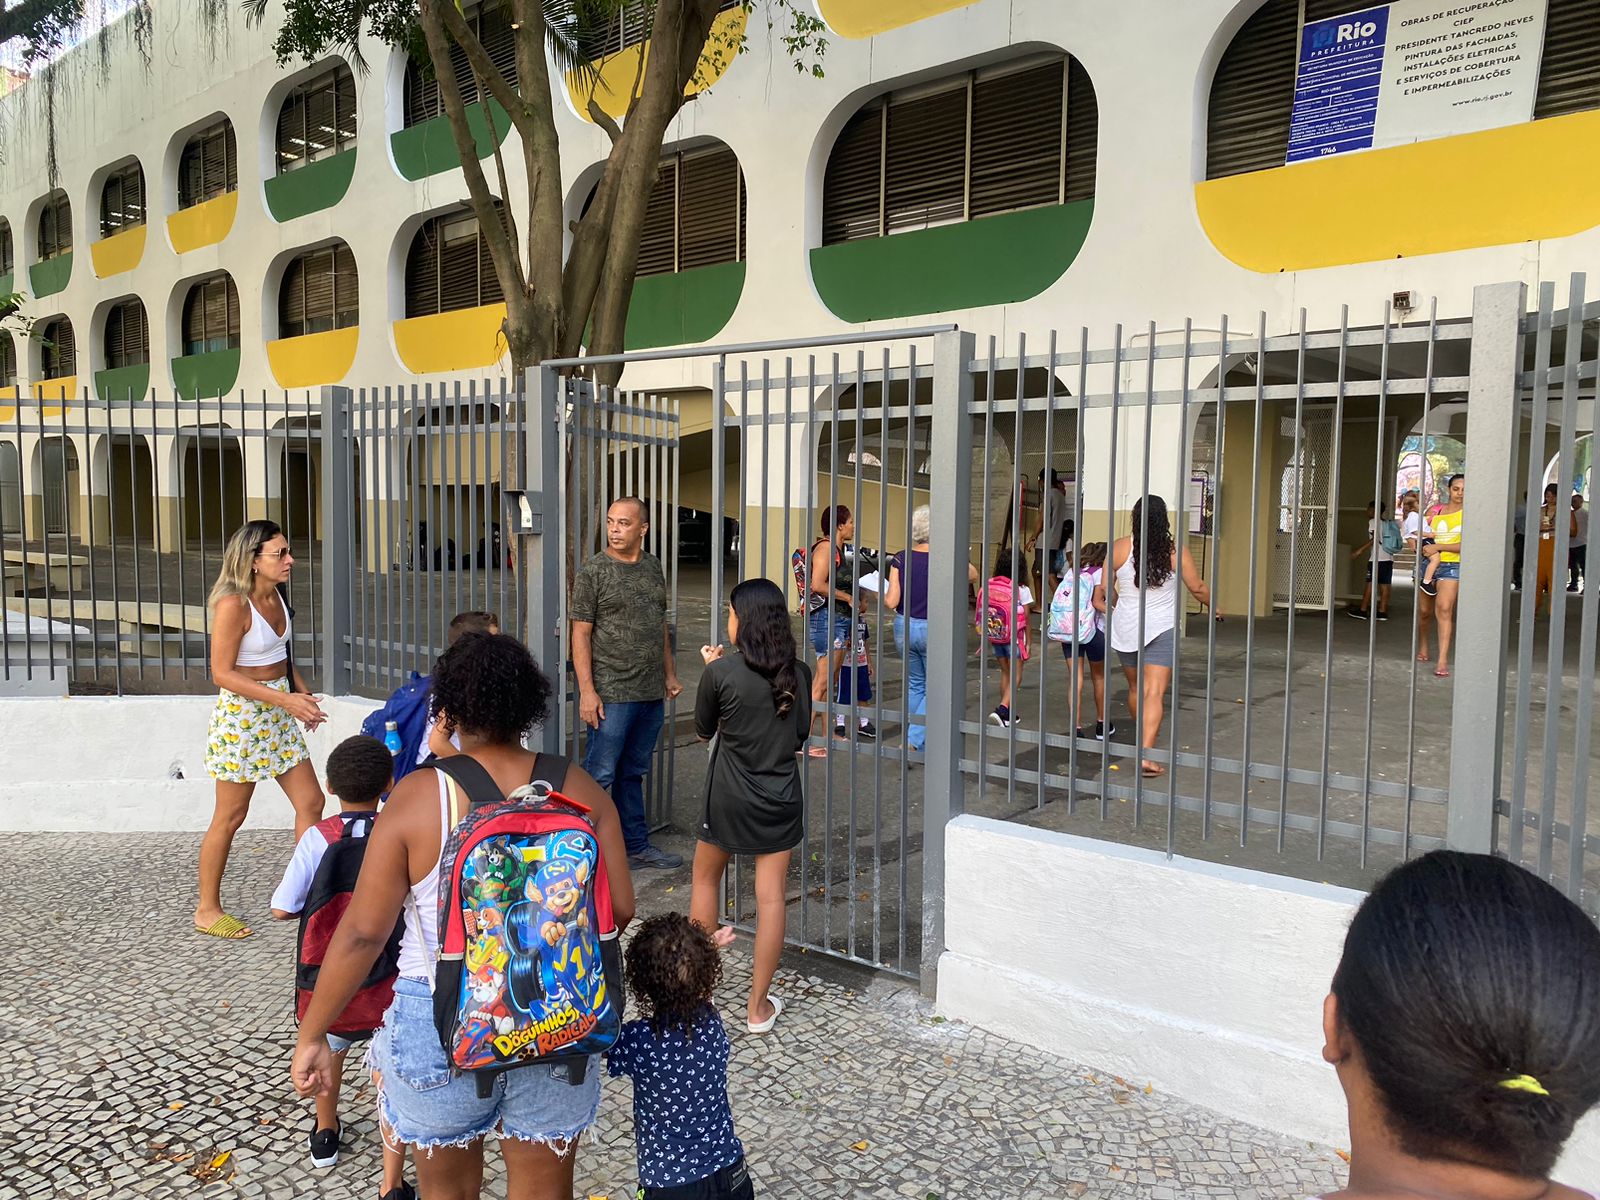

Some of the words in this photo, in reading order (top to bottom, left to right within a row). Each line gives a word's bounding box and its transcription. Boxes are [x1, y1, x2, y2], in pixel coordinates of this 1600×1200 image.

[1336, 21, 1377, 43] Rio
[1395, 34, 1448, 51] PRESIDENTE
[1451, 22, 1501, 39] TANCREDO
[1503, 15, 1534, 28] NEVES
[1400, 15, 1430, 27] OBRAS
[1432, 11, 1444, 20] DE
[1453, 16, 1474, 27] CIEP
[1311, 39, 1375, 57] PREFEITURA
[1403, 53, 1465, 72] INSTALAÇÕES
[1467, 42, 1517, 59] ELETRICAS
[1404, 48, 1443, 61] PINTURA
[1445, 42, 1463, 53] DAS
[1465, 31, 1518, 48] FACHADAS,
[1403, 69, 1448, 84] SERVIÇOS
[1450, 66, 1462, 74] DE
[1464, 54, 1521, 71] COBERTURA
[1411, 68, 1511, 94] IMPERMEABILIZAÇÕES
[1320, 146, 1337, 155] 1746
[492, 1004, 579, 1057] DOGUINHOS
[537, 1010, 597, 1056] RADICAIS
